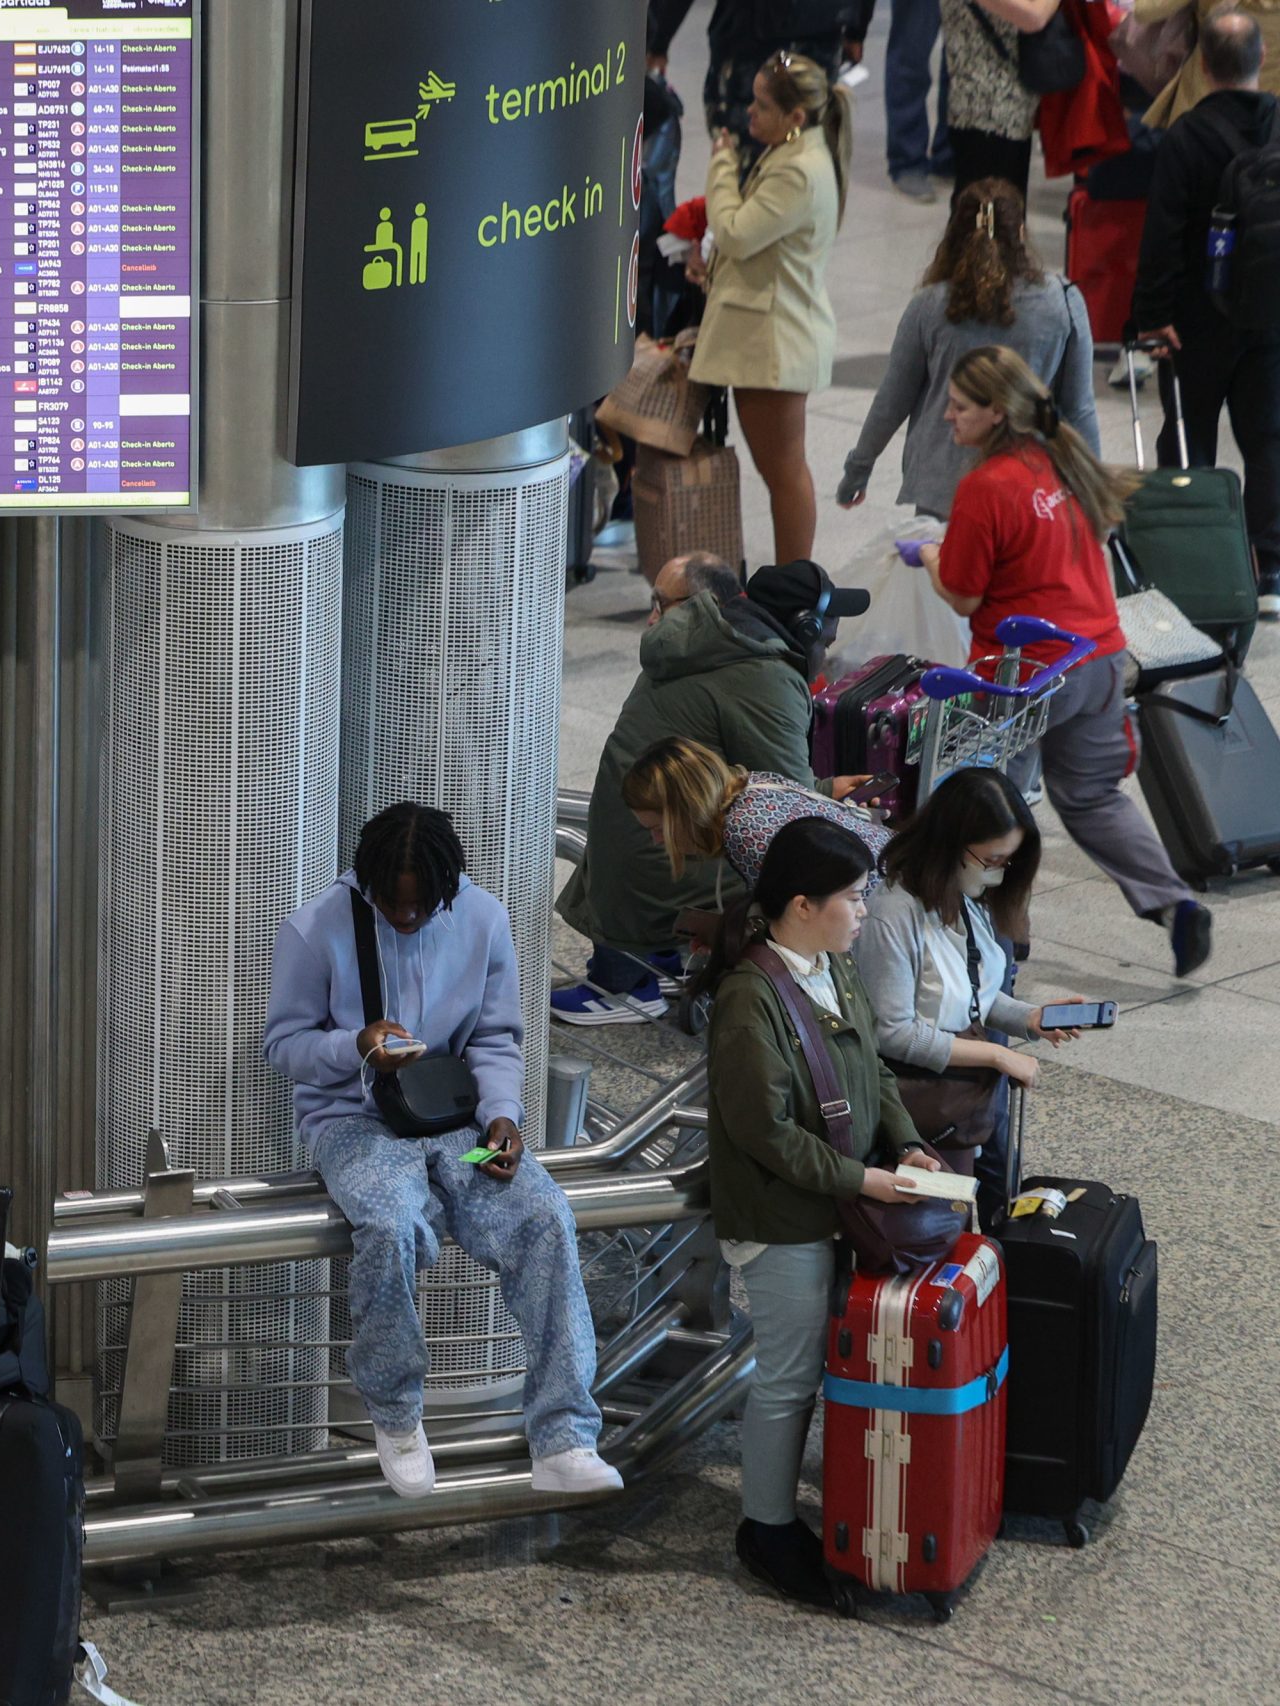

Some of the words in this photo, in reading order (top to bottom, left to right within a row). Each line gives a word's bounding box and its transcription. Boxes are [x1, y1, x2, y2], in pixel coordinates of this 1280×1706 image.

[122, 44, 152, 53] Check-in
[154, 44, 176, 53] Aberto
[485, 47, 611, 124] terminal
[615, 41, 626, 86] 2
[122, 84, 152, 93] Check-in
[154, 84, 176, 93] Aberto
[122, 125, 152, 133] Check-in
[154, 125, 176, 133] Aberto
[122, 165, 152, 173] Check-in
[154, 165, 176, 173] Aberto
[477, 184, 577, 248] check
[583, 175, 604, 219] in
[122, 244, 152, 252] Check-in
[154, 244, 176, 252] Aberto
[121, 284, 151, 292] Check-in
[153, 284, 175, 292] Aberto
[121, 441, 151, 449] Check-in
[153, 441, 175, 449] Aberto
[121, 460, 151, 468] Check-in
[153, 460, 175, 468] Aberto
